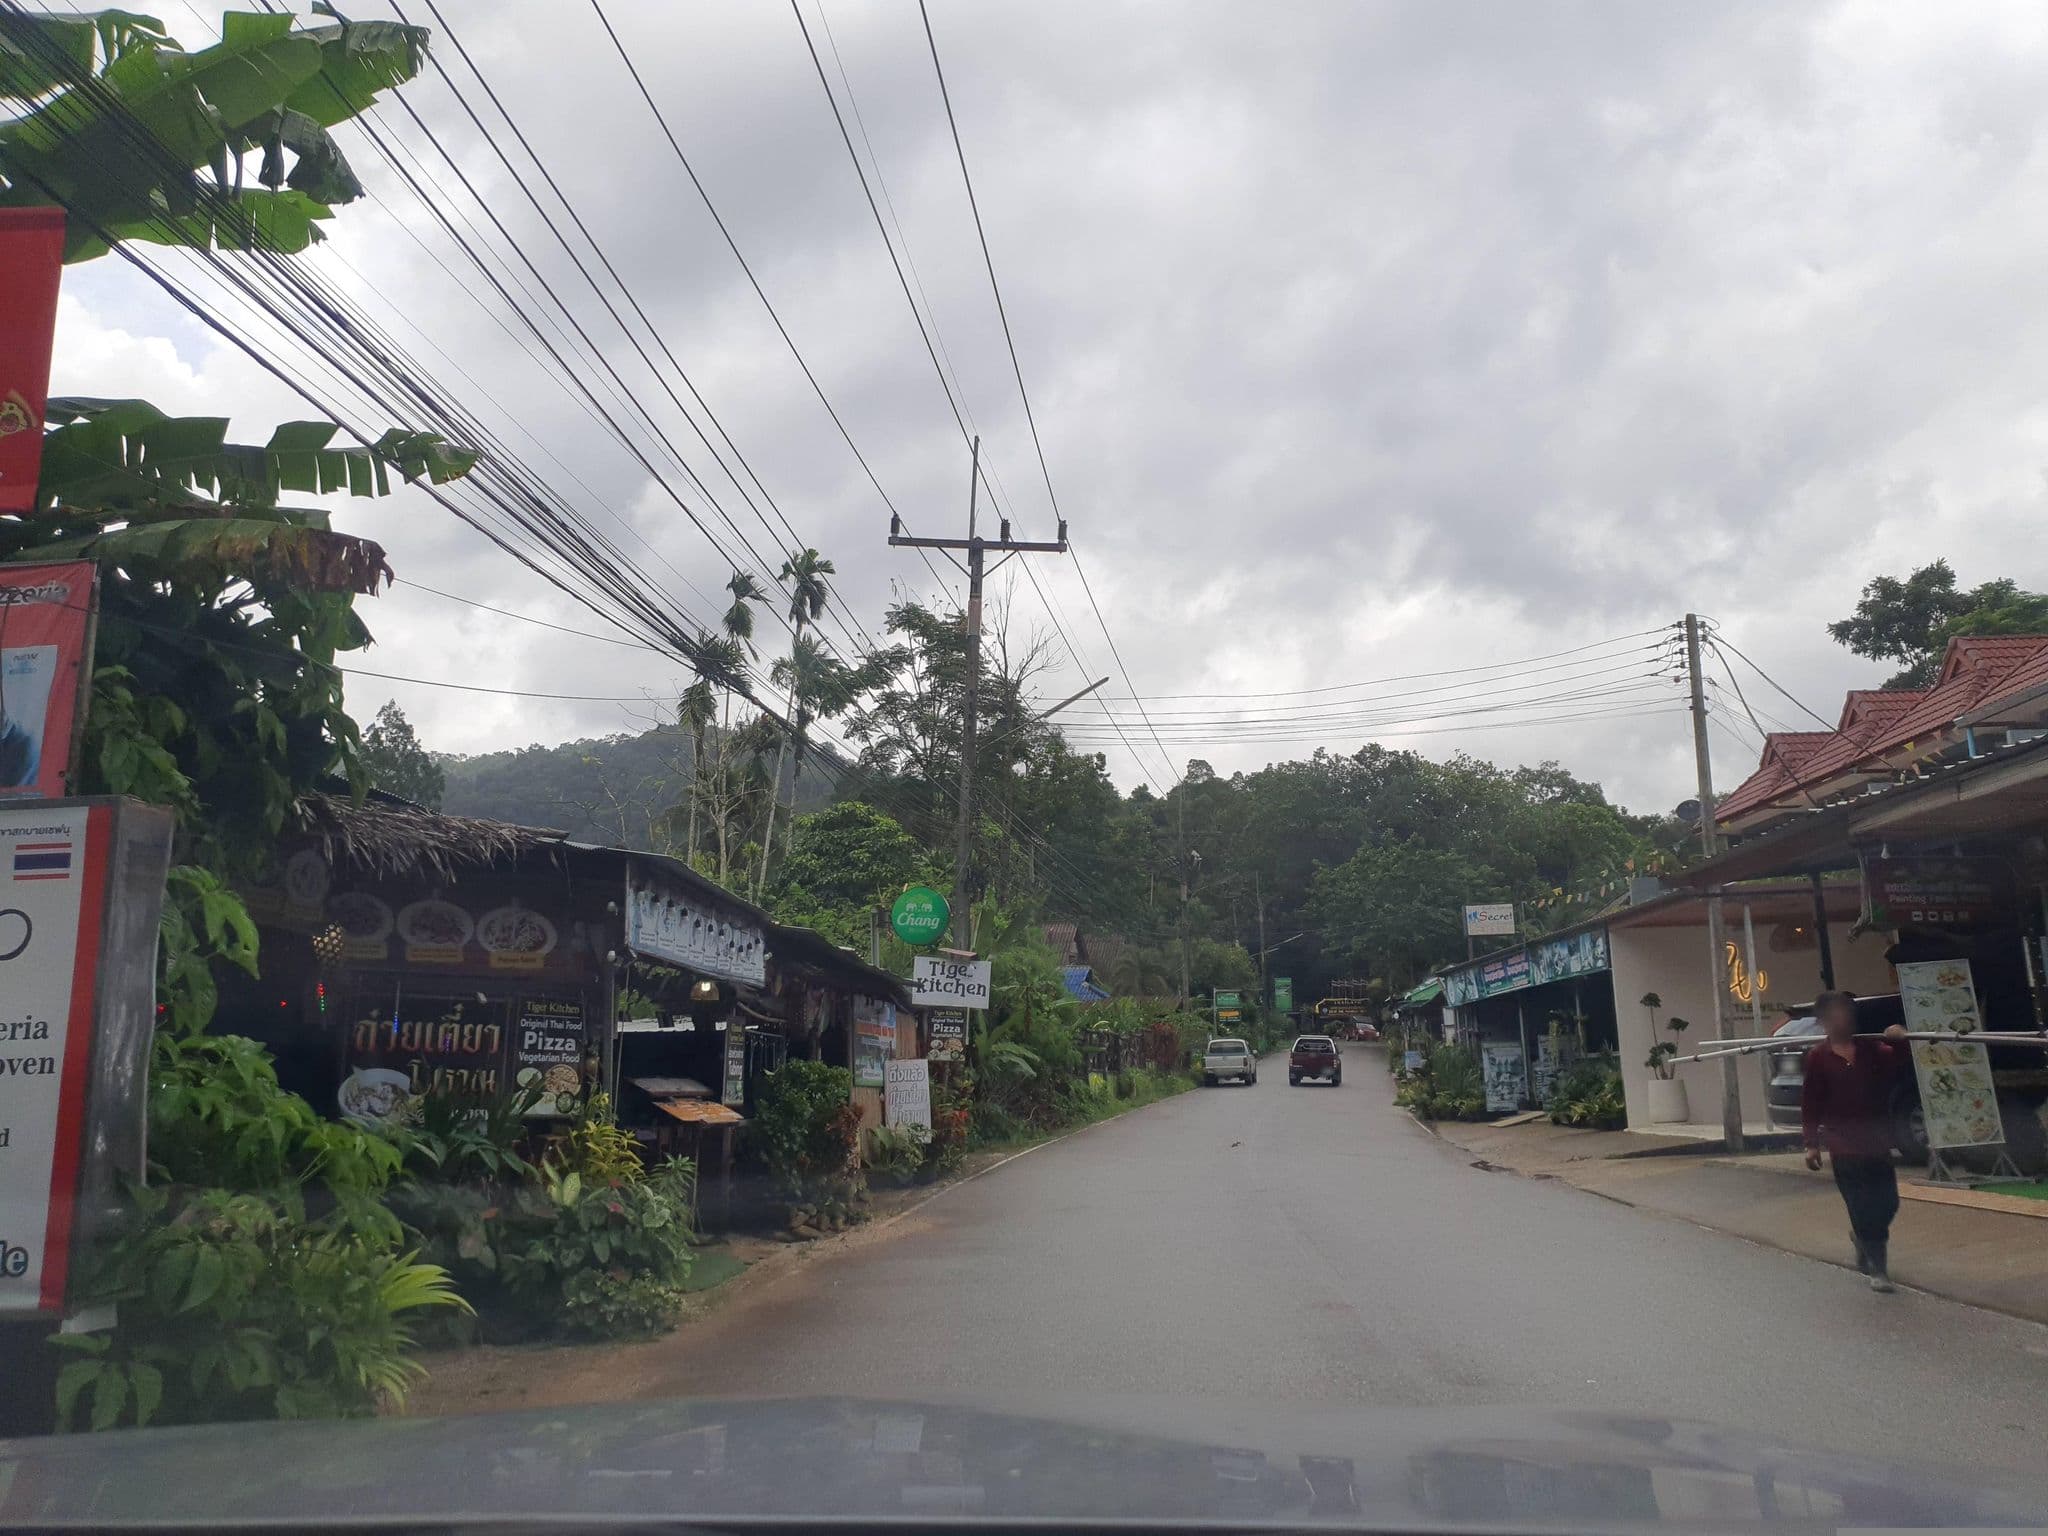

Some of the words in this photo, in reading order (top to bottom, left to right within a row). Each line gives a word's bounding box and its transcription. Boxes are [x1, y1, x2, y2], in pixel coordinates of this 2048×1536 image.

[896, 912, 940, 929] Chang
[916, 977, 987, 998] Kitchen
[527, 1001, 548, 1014] Tiger
[549, 1002, 580, 1014] Kitchen
[550, 1019, 565, 1030] Thai
[566, 1021, 583, 1031] Food
[933, 1023, 961, 1033] Pizza
[523, 1030, 577, 1052] Pizza
[518, 1051, 560, 1064] Vegetarian
[561, 1053, 581, 1063] Food
